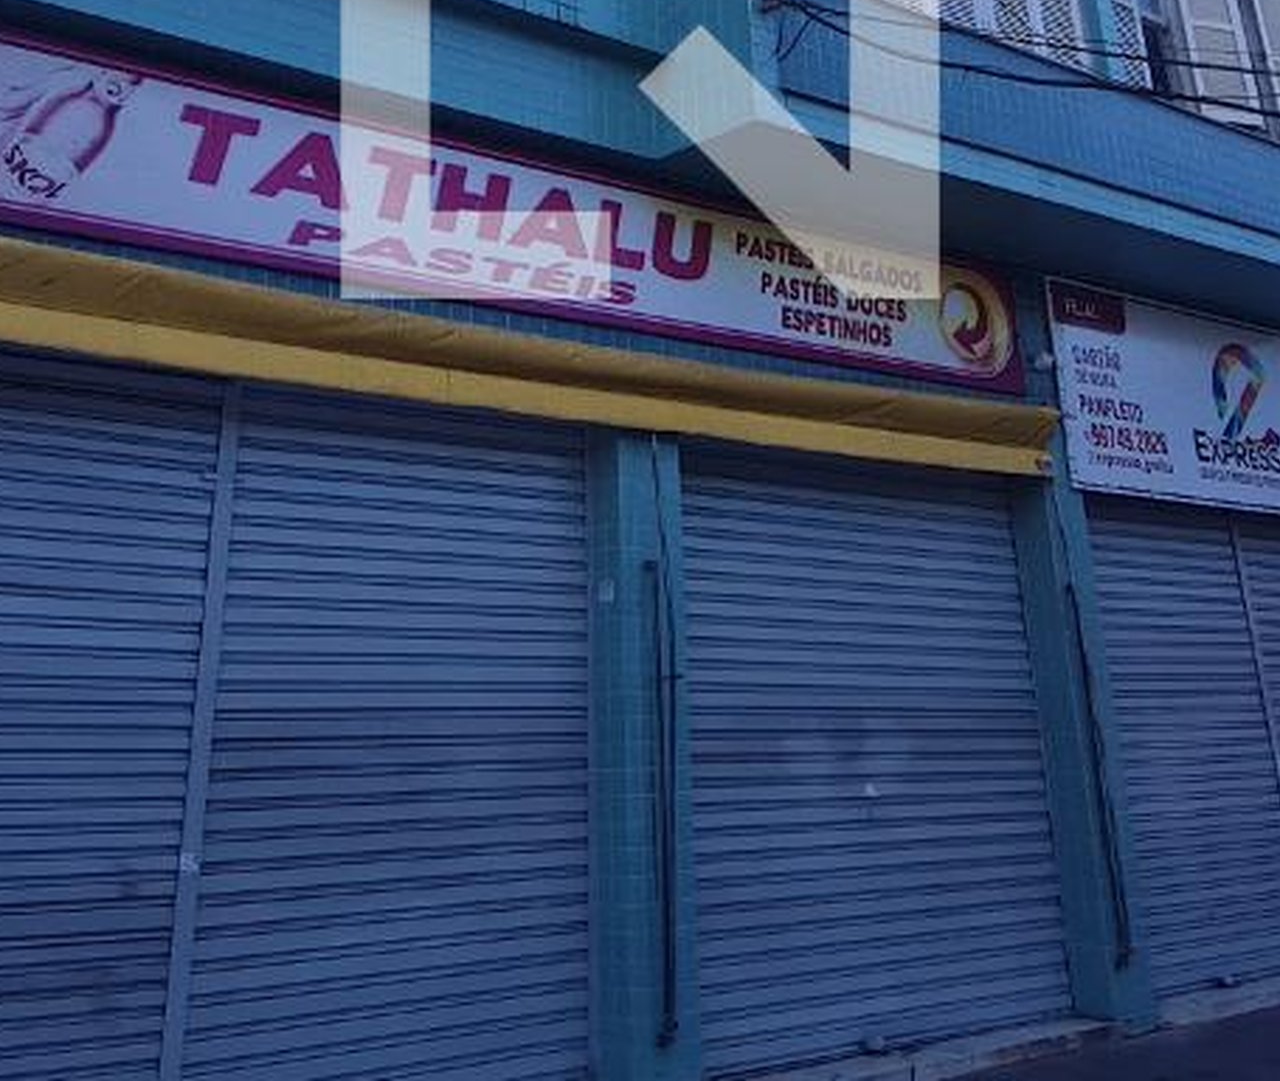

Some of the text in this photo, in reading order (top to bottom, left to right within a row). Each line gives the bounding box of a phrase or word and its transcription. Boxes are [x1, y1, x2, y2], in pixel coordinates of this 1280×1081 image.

[179, 103, 714, 281] TATHALU
[287, 219, 638, 307] PASTÉIS
[760, 271, 908, 323] PASTÉIS DOCES
[780, 305, 894, 348] ESPETINHOS
